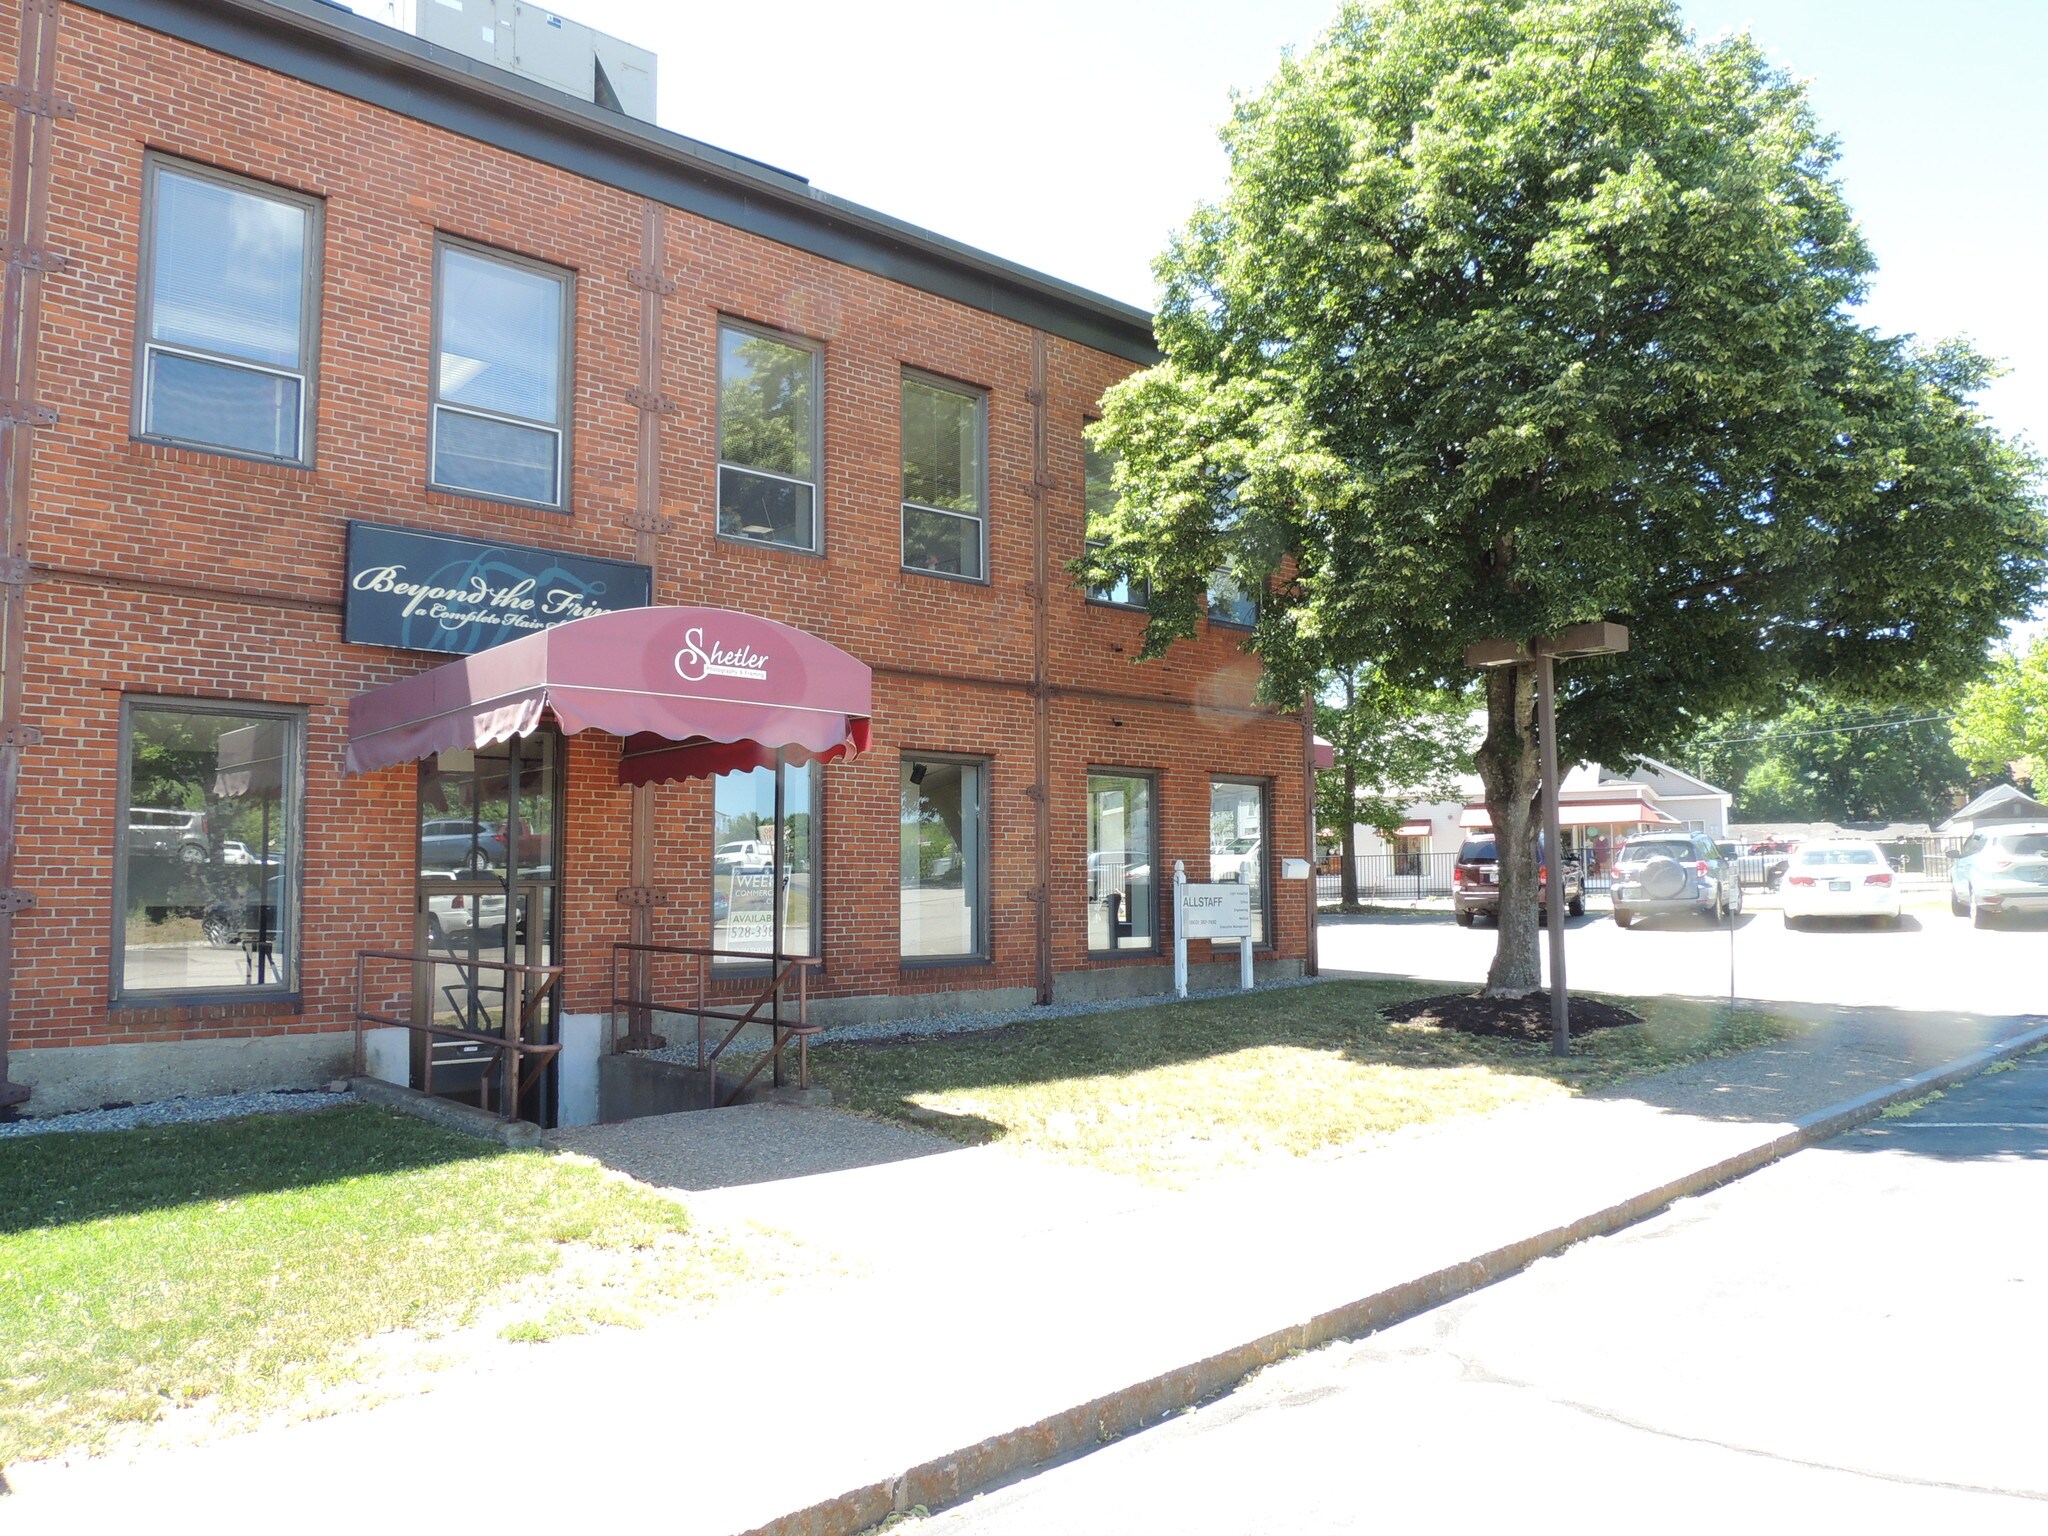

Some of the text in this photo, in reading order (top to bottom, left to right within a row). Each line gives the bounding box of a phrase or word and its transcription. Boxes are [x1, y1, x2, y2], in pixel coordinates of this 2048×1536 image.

[352, 565, 612, 618] Beyond the Frin
[414, 608, 428, 616] a
[429, 603, 501, 630] Complete
[501, 613, 545, 629] Hair
[674, 627, 770, 681] Shetler
[736, 875, 774, 888] WEE
[735, 889, 774, 897] COMMERC
[1183, 896, 1222, 907] ALLSTAFF
[732, 914, 773, 923] AVAILAB
